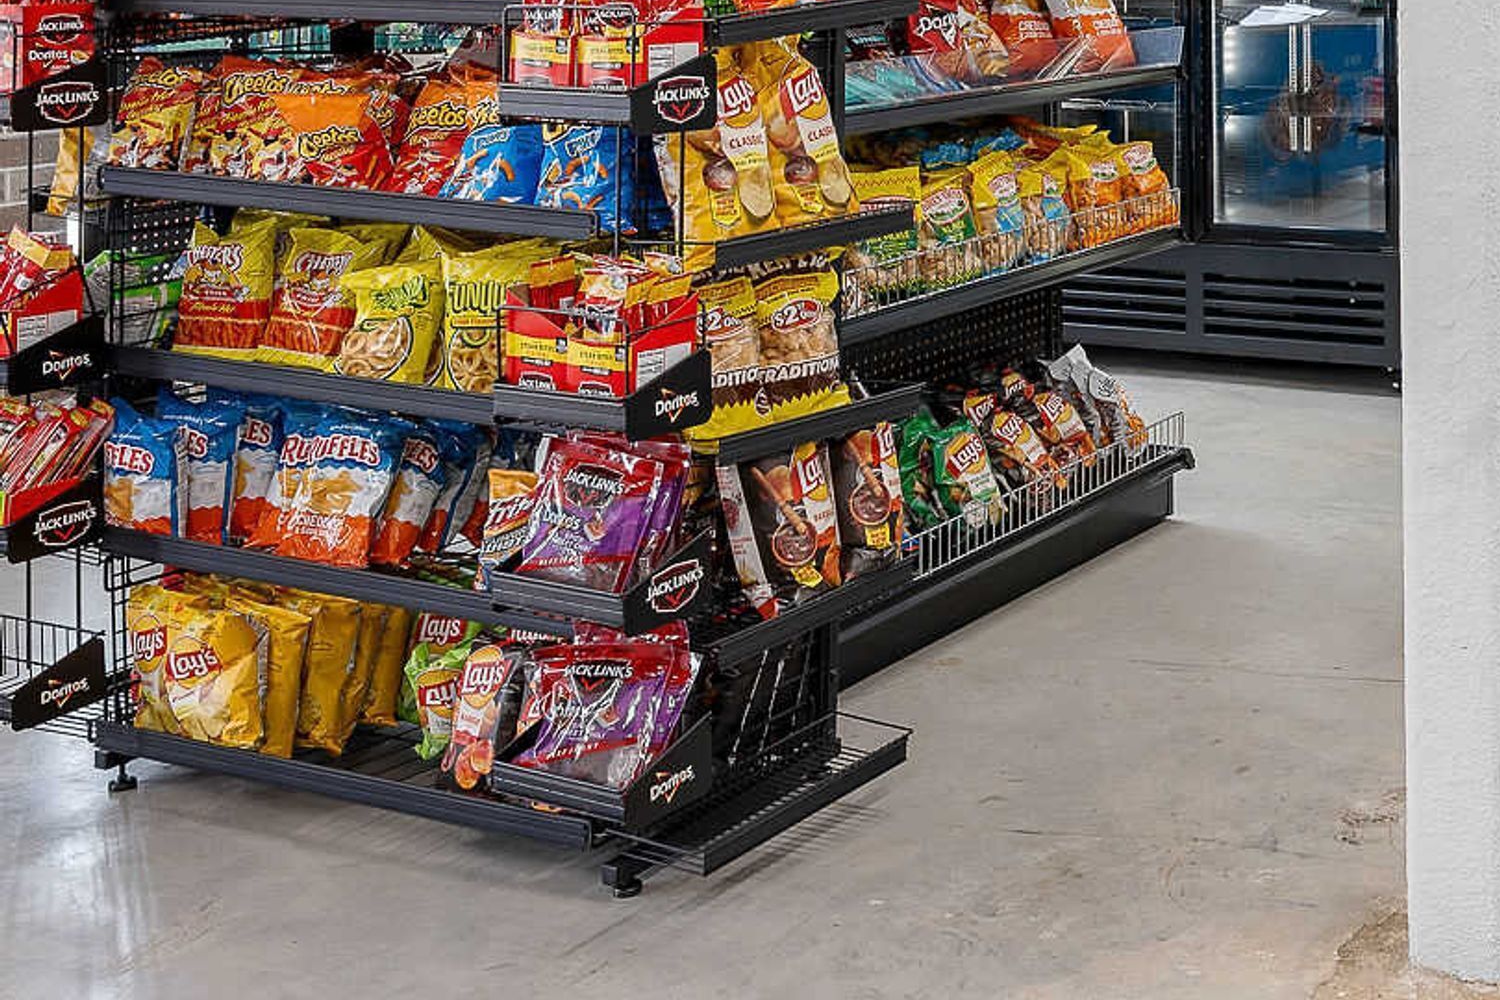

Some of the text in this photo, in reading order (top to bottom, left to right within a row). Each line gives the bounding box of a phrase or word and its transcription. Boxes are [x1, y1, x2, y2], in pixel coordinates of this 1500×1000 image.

[36, 89, 100, 105] JACK LINK'S
[652, 85, 710, 105] JACK LINK'S
[42, 352, 92, 376] Doritos
[655, 391, 698, 417] Doritos
[563, 470, 591, 486] JACK
[33, 516, 62, 536] JACK
[647, 582, 672, 601] JACK
[132, 627, 164, 661] Lay's
[169, 648, 219, 679] Lay's
[41, 677, 89, 705] Doritos
